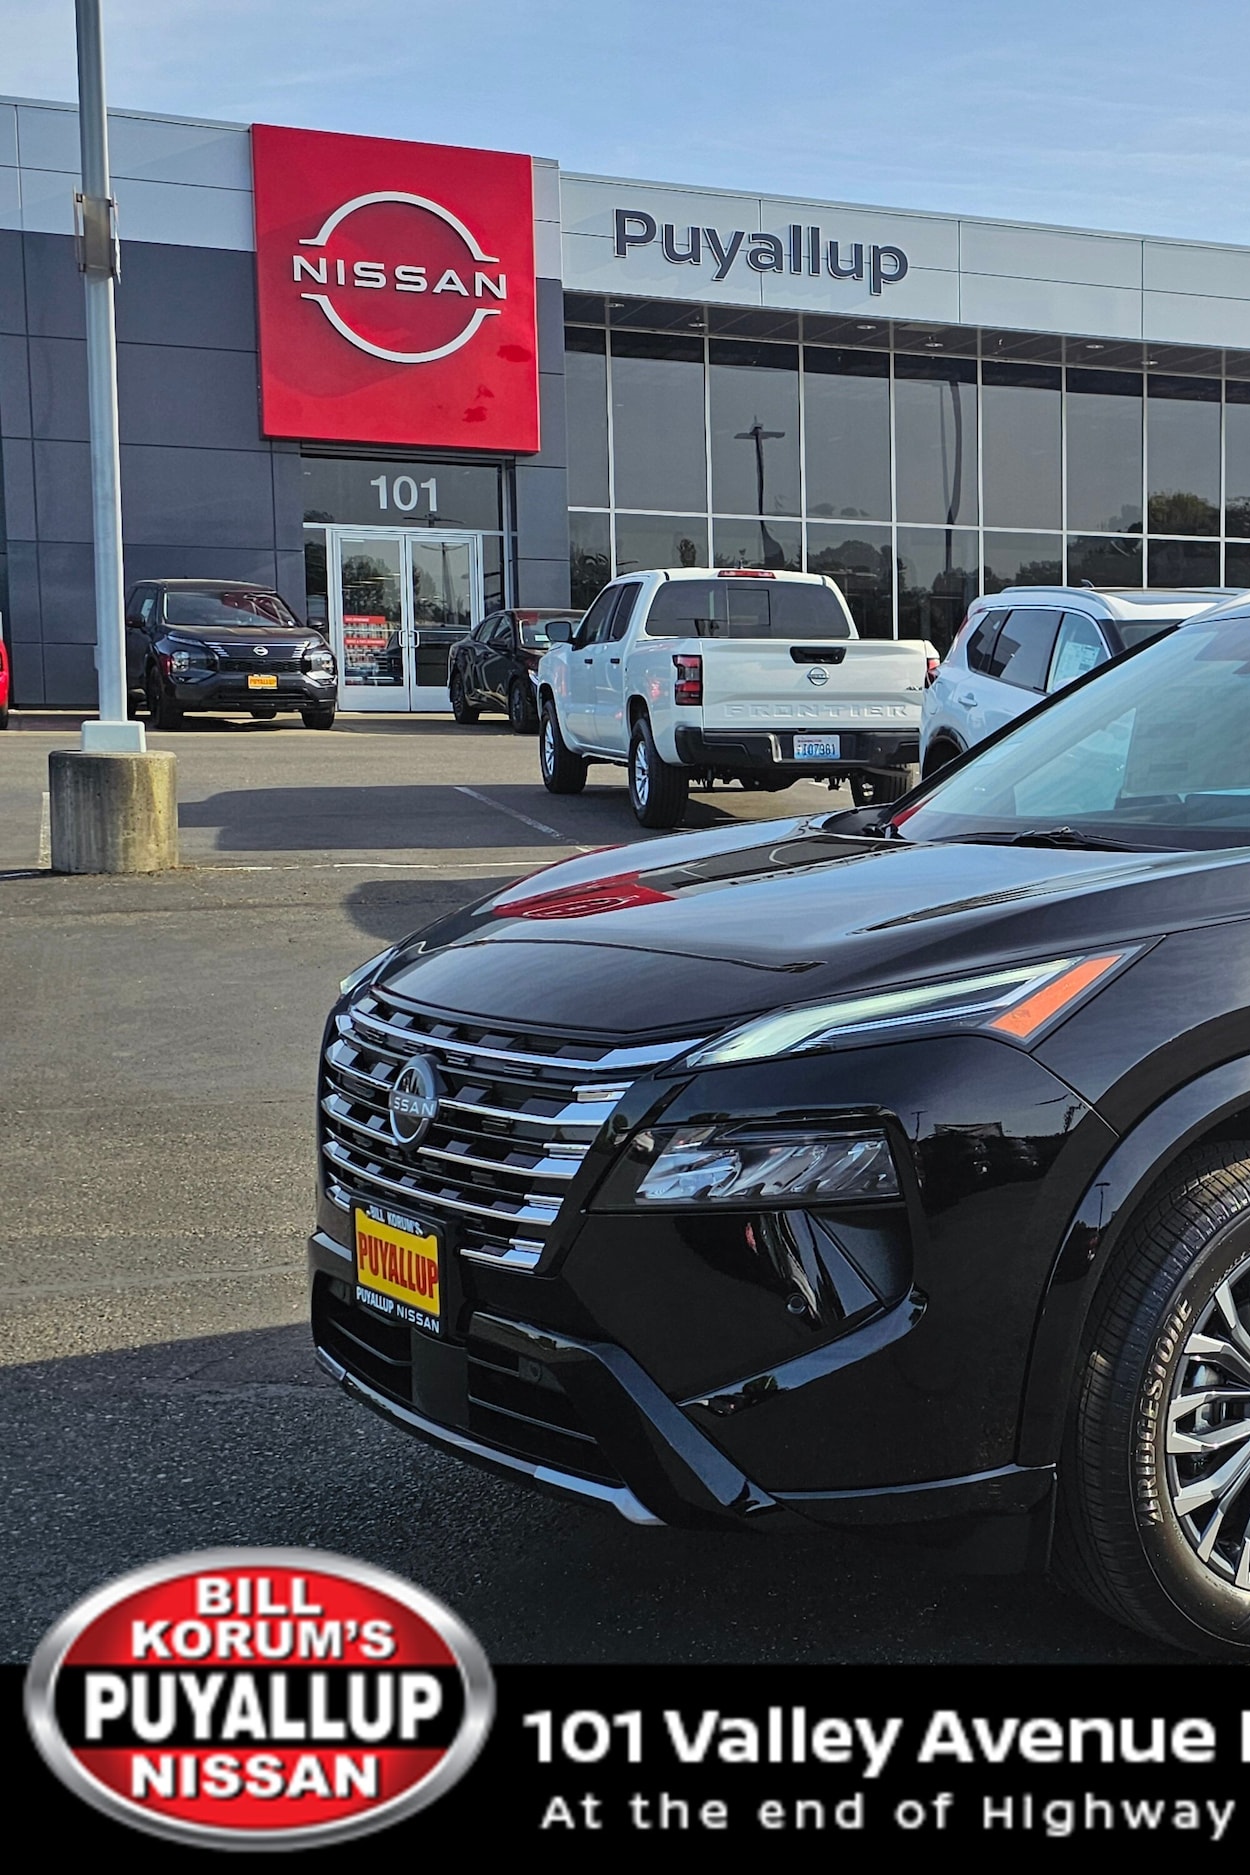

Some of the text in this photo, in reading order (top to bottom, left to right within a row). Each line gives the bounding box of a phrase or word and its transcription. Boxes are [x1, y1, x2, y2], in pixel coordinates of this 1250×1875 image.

[613, 208, 909, 296] Puyallup
[292, 254, 508, 301] NISSAN
[370, 475, 439, 513] 101
[724, 703, 908, 718] FRONTIER
[358, 1231, 438, 1300] PUYALLUP
[356, 1286, 440, 1334] PUYALLUP NISSAN
[1135, 1294, 1193, 1528] BRIDGESTONE
